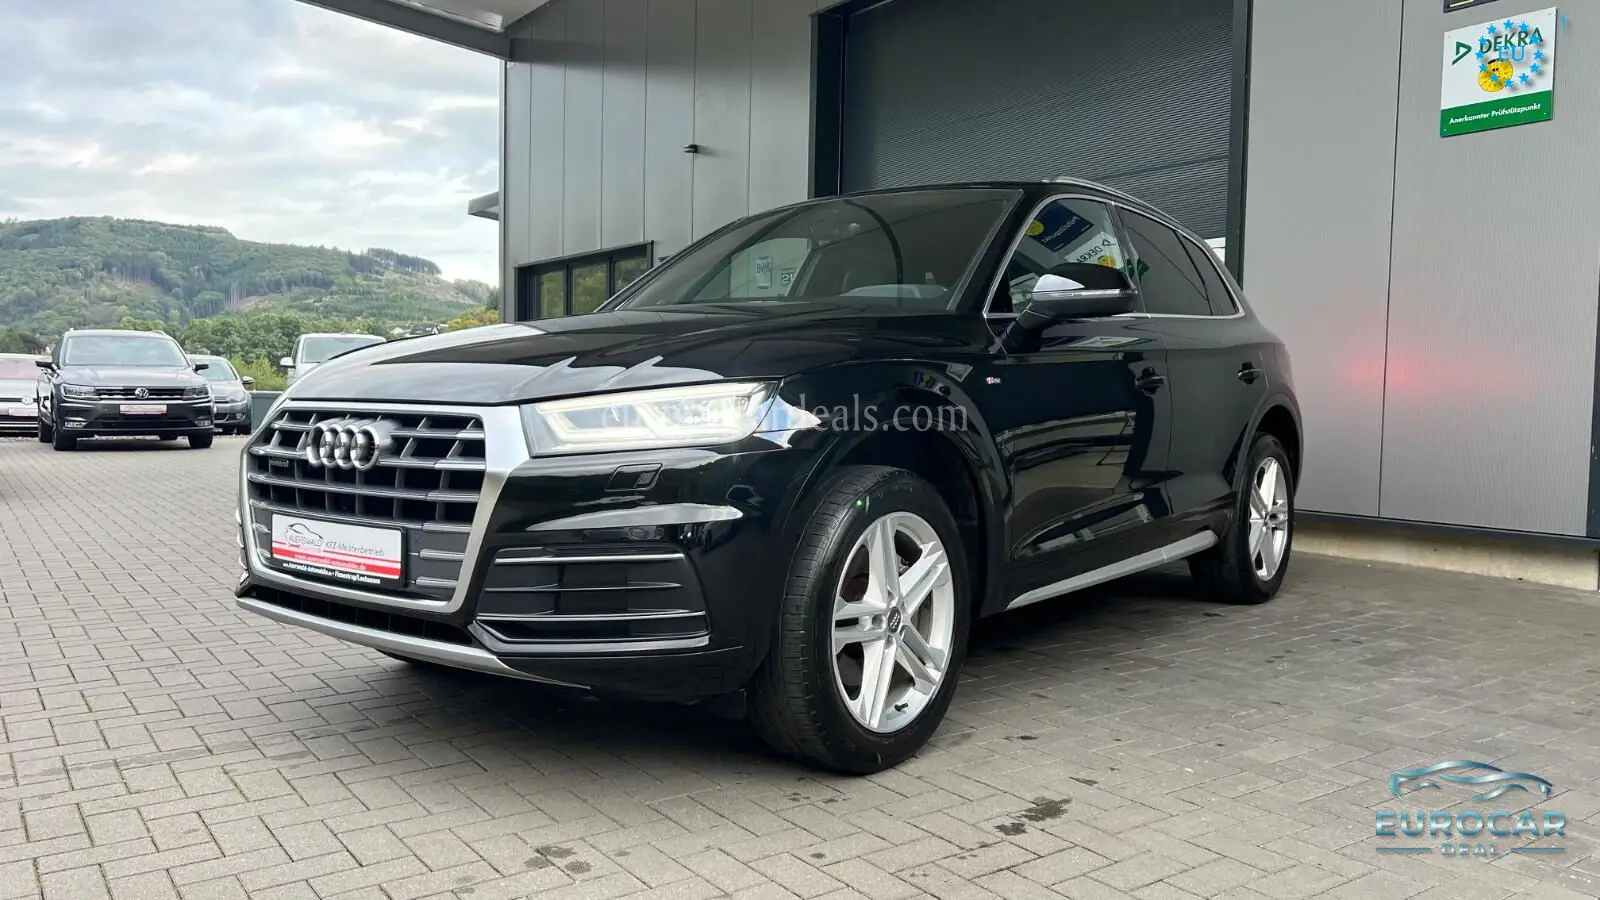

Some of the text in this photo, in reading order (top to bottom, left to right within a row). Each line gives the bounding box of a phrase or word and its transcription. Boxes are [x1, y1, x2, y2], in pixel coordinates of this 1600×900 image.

[1480, 27, 1543, 54] DEKRA
[1449, 102, 1541, 125] Anerkannter Prüfstützpunkt
